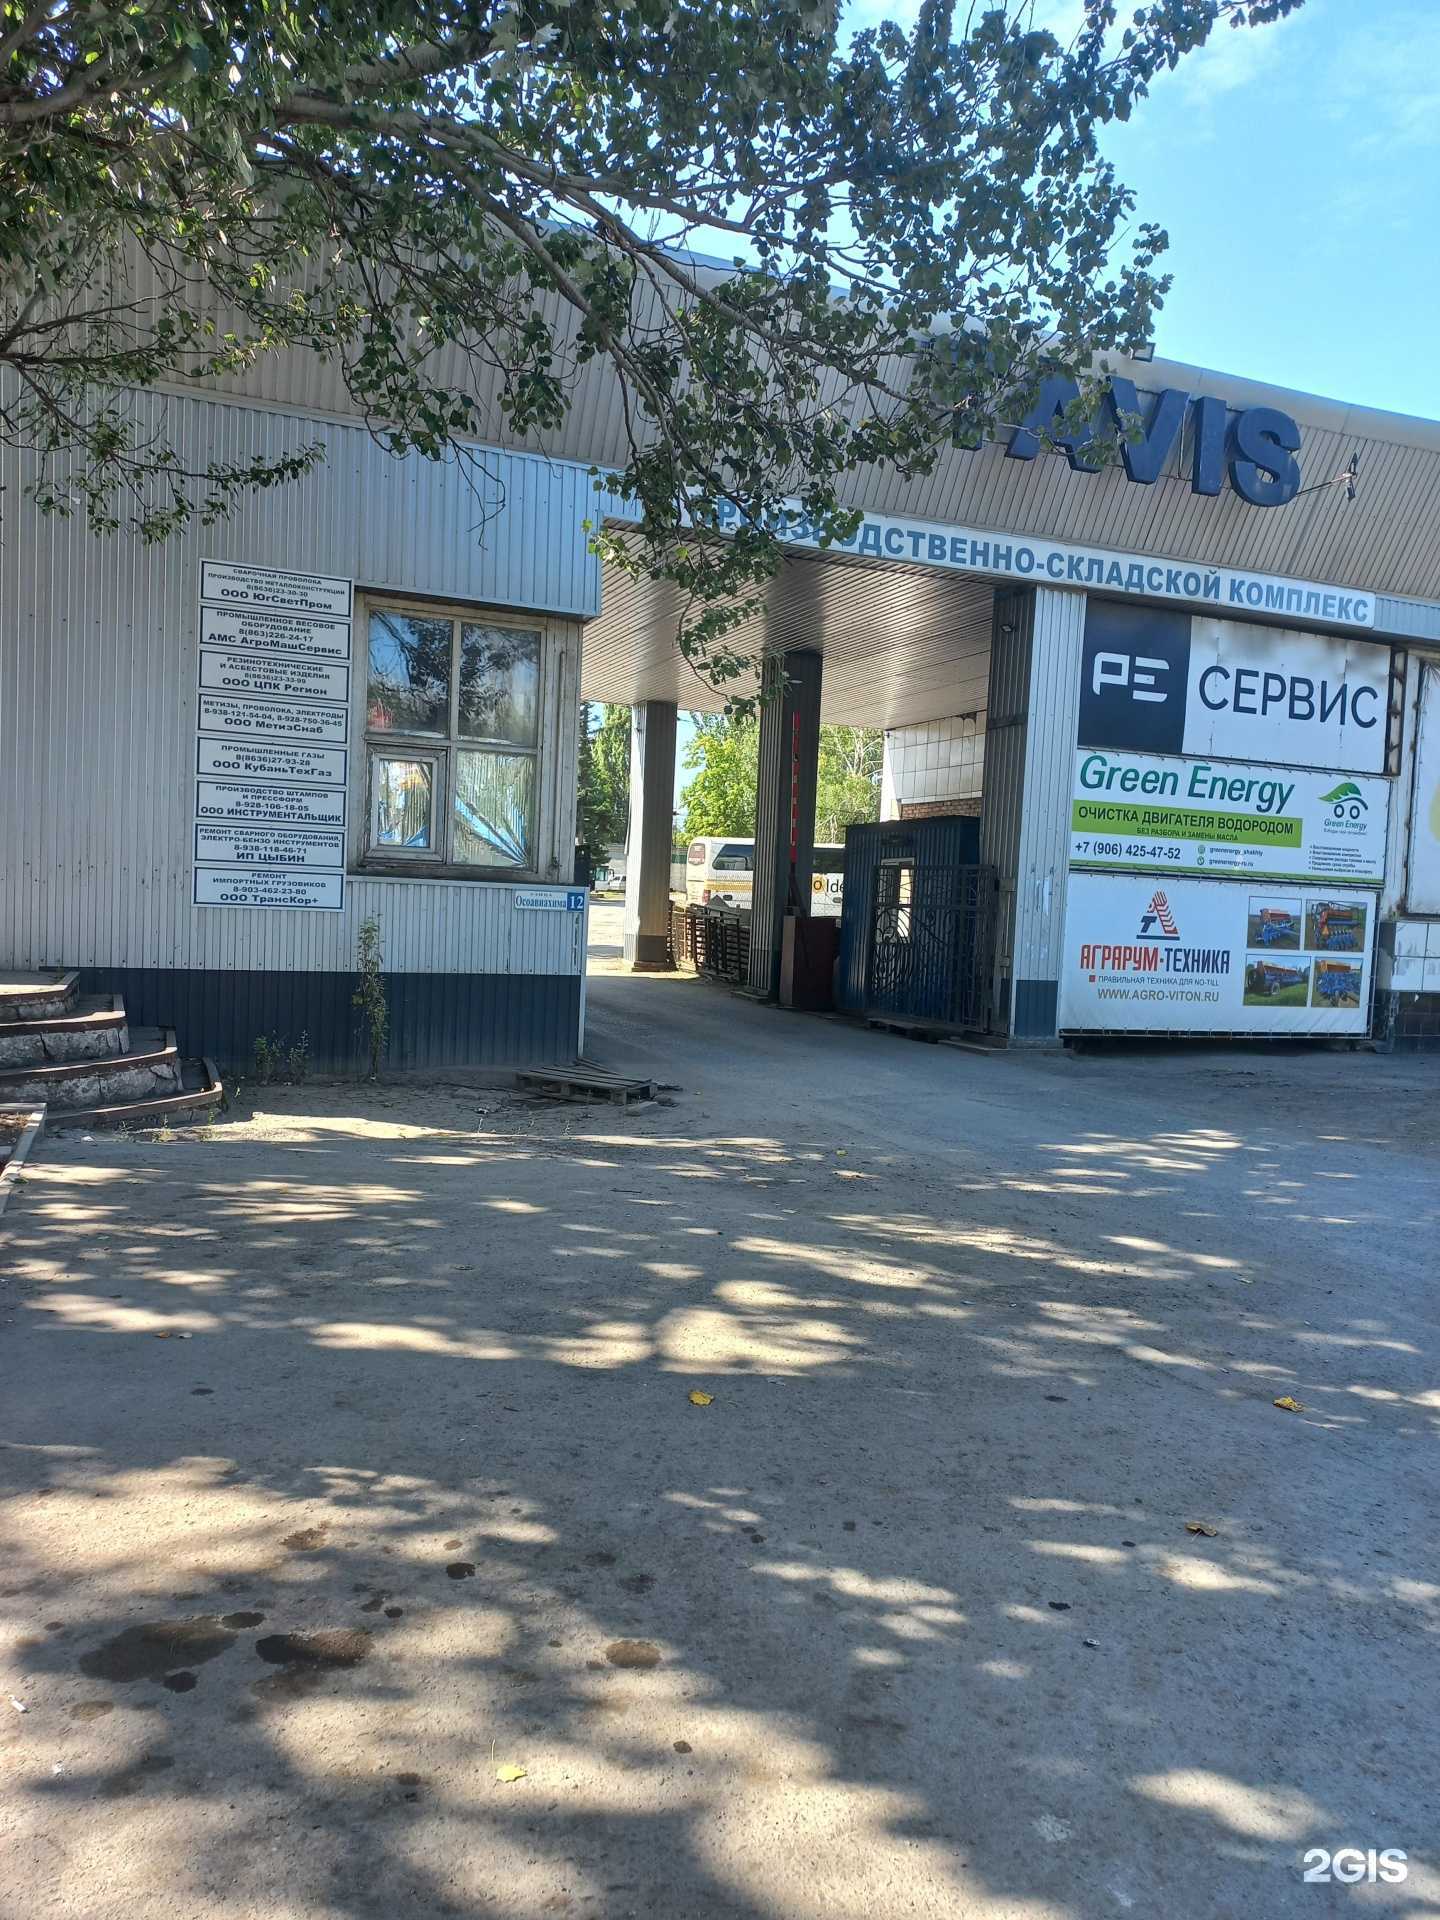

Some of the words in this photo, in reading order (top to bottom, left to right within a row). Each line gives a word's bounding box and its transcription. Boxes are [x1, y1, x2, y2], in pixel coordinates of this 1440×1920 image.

[208, 573, 263, 584] ПРОИЗВОДСТВО
[279, 575, 321, 584] ПРОВОЛОКА
[221, 589, 248, 598] ООО
[254, 593, 332, 609] ЮгСветПром
[1229, 579, 1369, 622] КОМПЛЕКС
[217, 611, 293, 625] ПРОМЫШЛЕННОЕ
[296, 621, 335, 629] ВЕСОВОЕ
[242, 621, 311, 633] ОБОРУДОВАНИЕ
[239, 629, 314, 642] 8(863)226-24-17
[209, 634, 236, 642] АМС
[240, 637, 342, 655] АгроМашСервис
[227, 657, 323, 672] РЕЗИНОТЕХНИЧЕСКИЕ
[229, 665, 288, 675] АСБЕСТОВЫЕ
[291, 671, 329, 679] ИЗДЕЛИЯ
[223, 678, 249, 686] ООО
[255, 680, 280, 690] ЦПК
[285, 684, 327, 695] Регион
[1199, 665, 1379, 729] СЕРВИС
[203, 701, 240, 709] МЕТИЗЫ,
[243, 704, 293, 715] ПРОВОЛОКА,
[296, 710, 344, 719] ЭЛЕКТРОДЫ
[225, 718, 251, 726] ООО
[256, 721, 323, 733] МетизСнаб
[222, 745, 298, 757] ПРОМЫШЛЕННЫЕ
[245, 763, 332, 776] КубаньТехГаз
[216, 786, 284, 796] ПРОИЗВОДСТВО
[1080, 755, 1179, 796] Green
[1187, 765, 1295, 814] Energy
[227, 809, 341, 822] ИНСТРУМЕНТАЛЬЩИК
[1079, 806, 1139, 822] ОЧИСТКА
[1142, 810, 1214, 829] ДВИГАТЕЛЯ
[1218, 817, 1294, 835] ВОДОРОДОМ
[1136, 827, 1150, 835] БЕЗ
[1150, 829, 1180, 838] РАЗБОРА
[1181, 830, 1187, 838] И
[1187, 830, 1214, 840] ЗАМЕНЫ
[1216, 833, 1238, 841] МАСЛА
[274, 839, 339, 847] ИНСТРУМЕНТОВ
[1075, 841, 1090, 851] +7
[1093, 842, 1122, 858] (906)
[1125, 845, 1181, 860] 425-47-52
[259, 854, 304, 862] ЦЫБИН
[252, 895, 319, 904] ТрансКор+
[516, 896, 567, 908] Осоавиахима
[570, 896, 584, 909] 12
[1098, 975, 1145, 985] ПРАВИЛЬНАЯ
[1147, 976, 1178, 986] ТЕХНИКА
[1178, 978, 1193, 987] ДЛЯ
[1194, 979, 1219, 987] NO-TILL
[1097, 988, 1219, 1002] WWW.AGRO-VITON.RU
